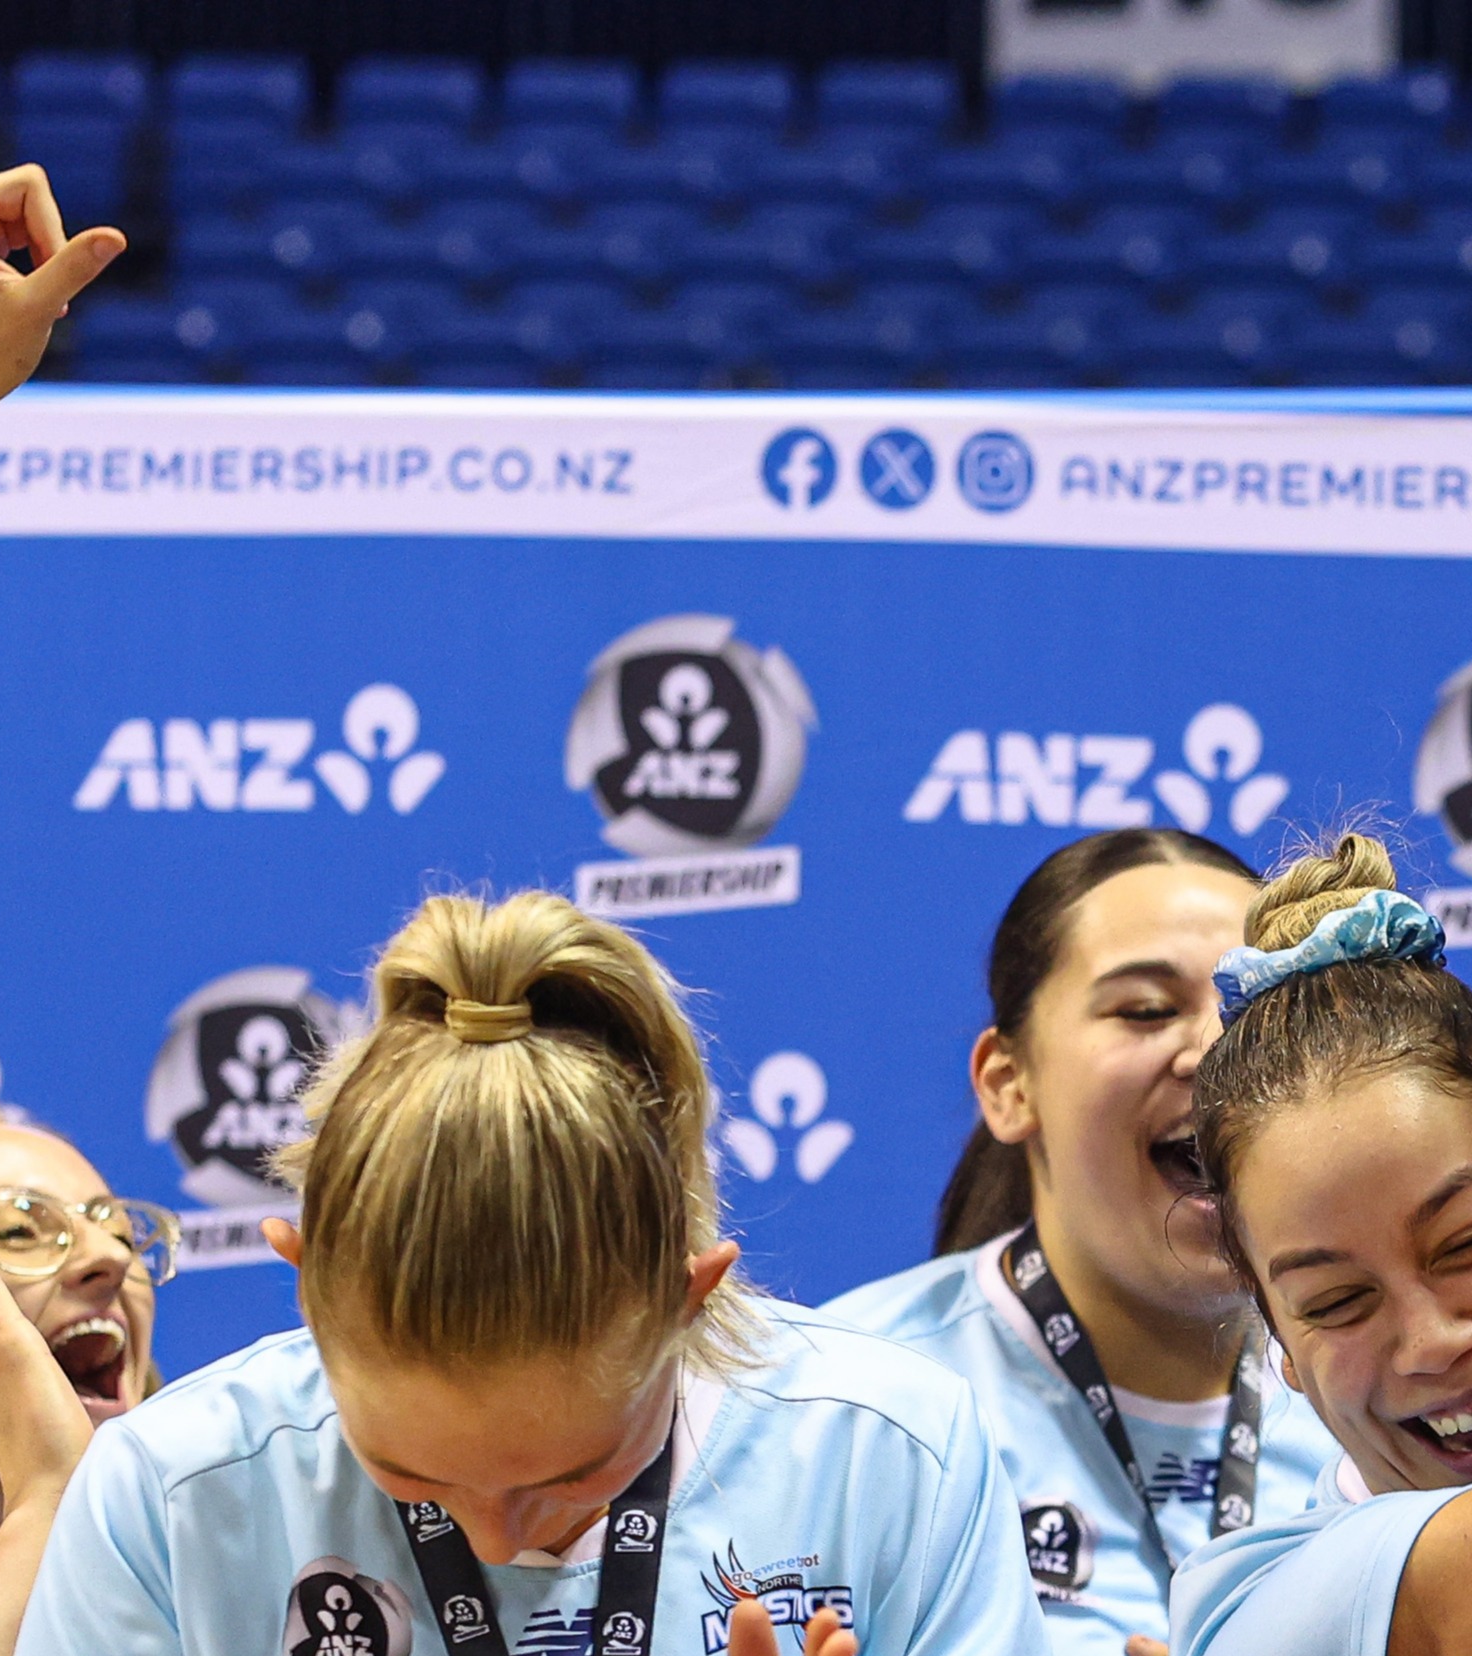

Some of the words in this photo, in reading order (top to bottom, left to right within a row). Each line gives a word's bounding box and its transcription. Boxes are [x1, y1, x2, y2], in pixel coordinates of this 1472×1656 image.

[72, 718, 315, 812] ANZ
[624, 750, 740, 800] ANZ
[902, 729, 1155, 829] ANZ
[757, 1575, 803, 1594] NORTHE
[701, 1587, 854, 1656] MSTICS
